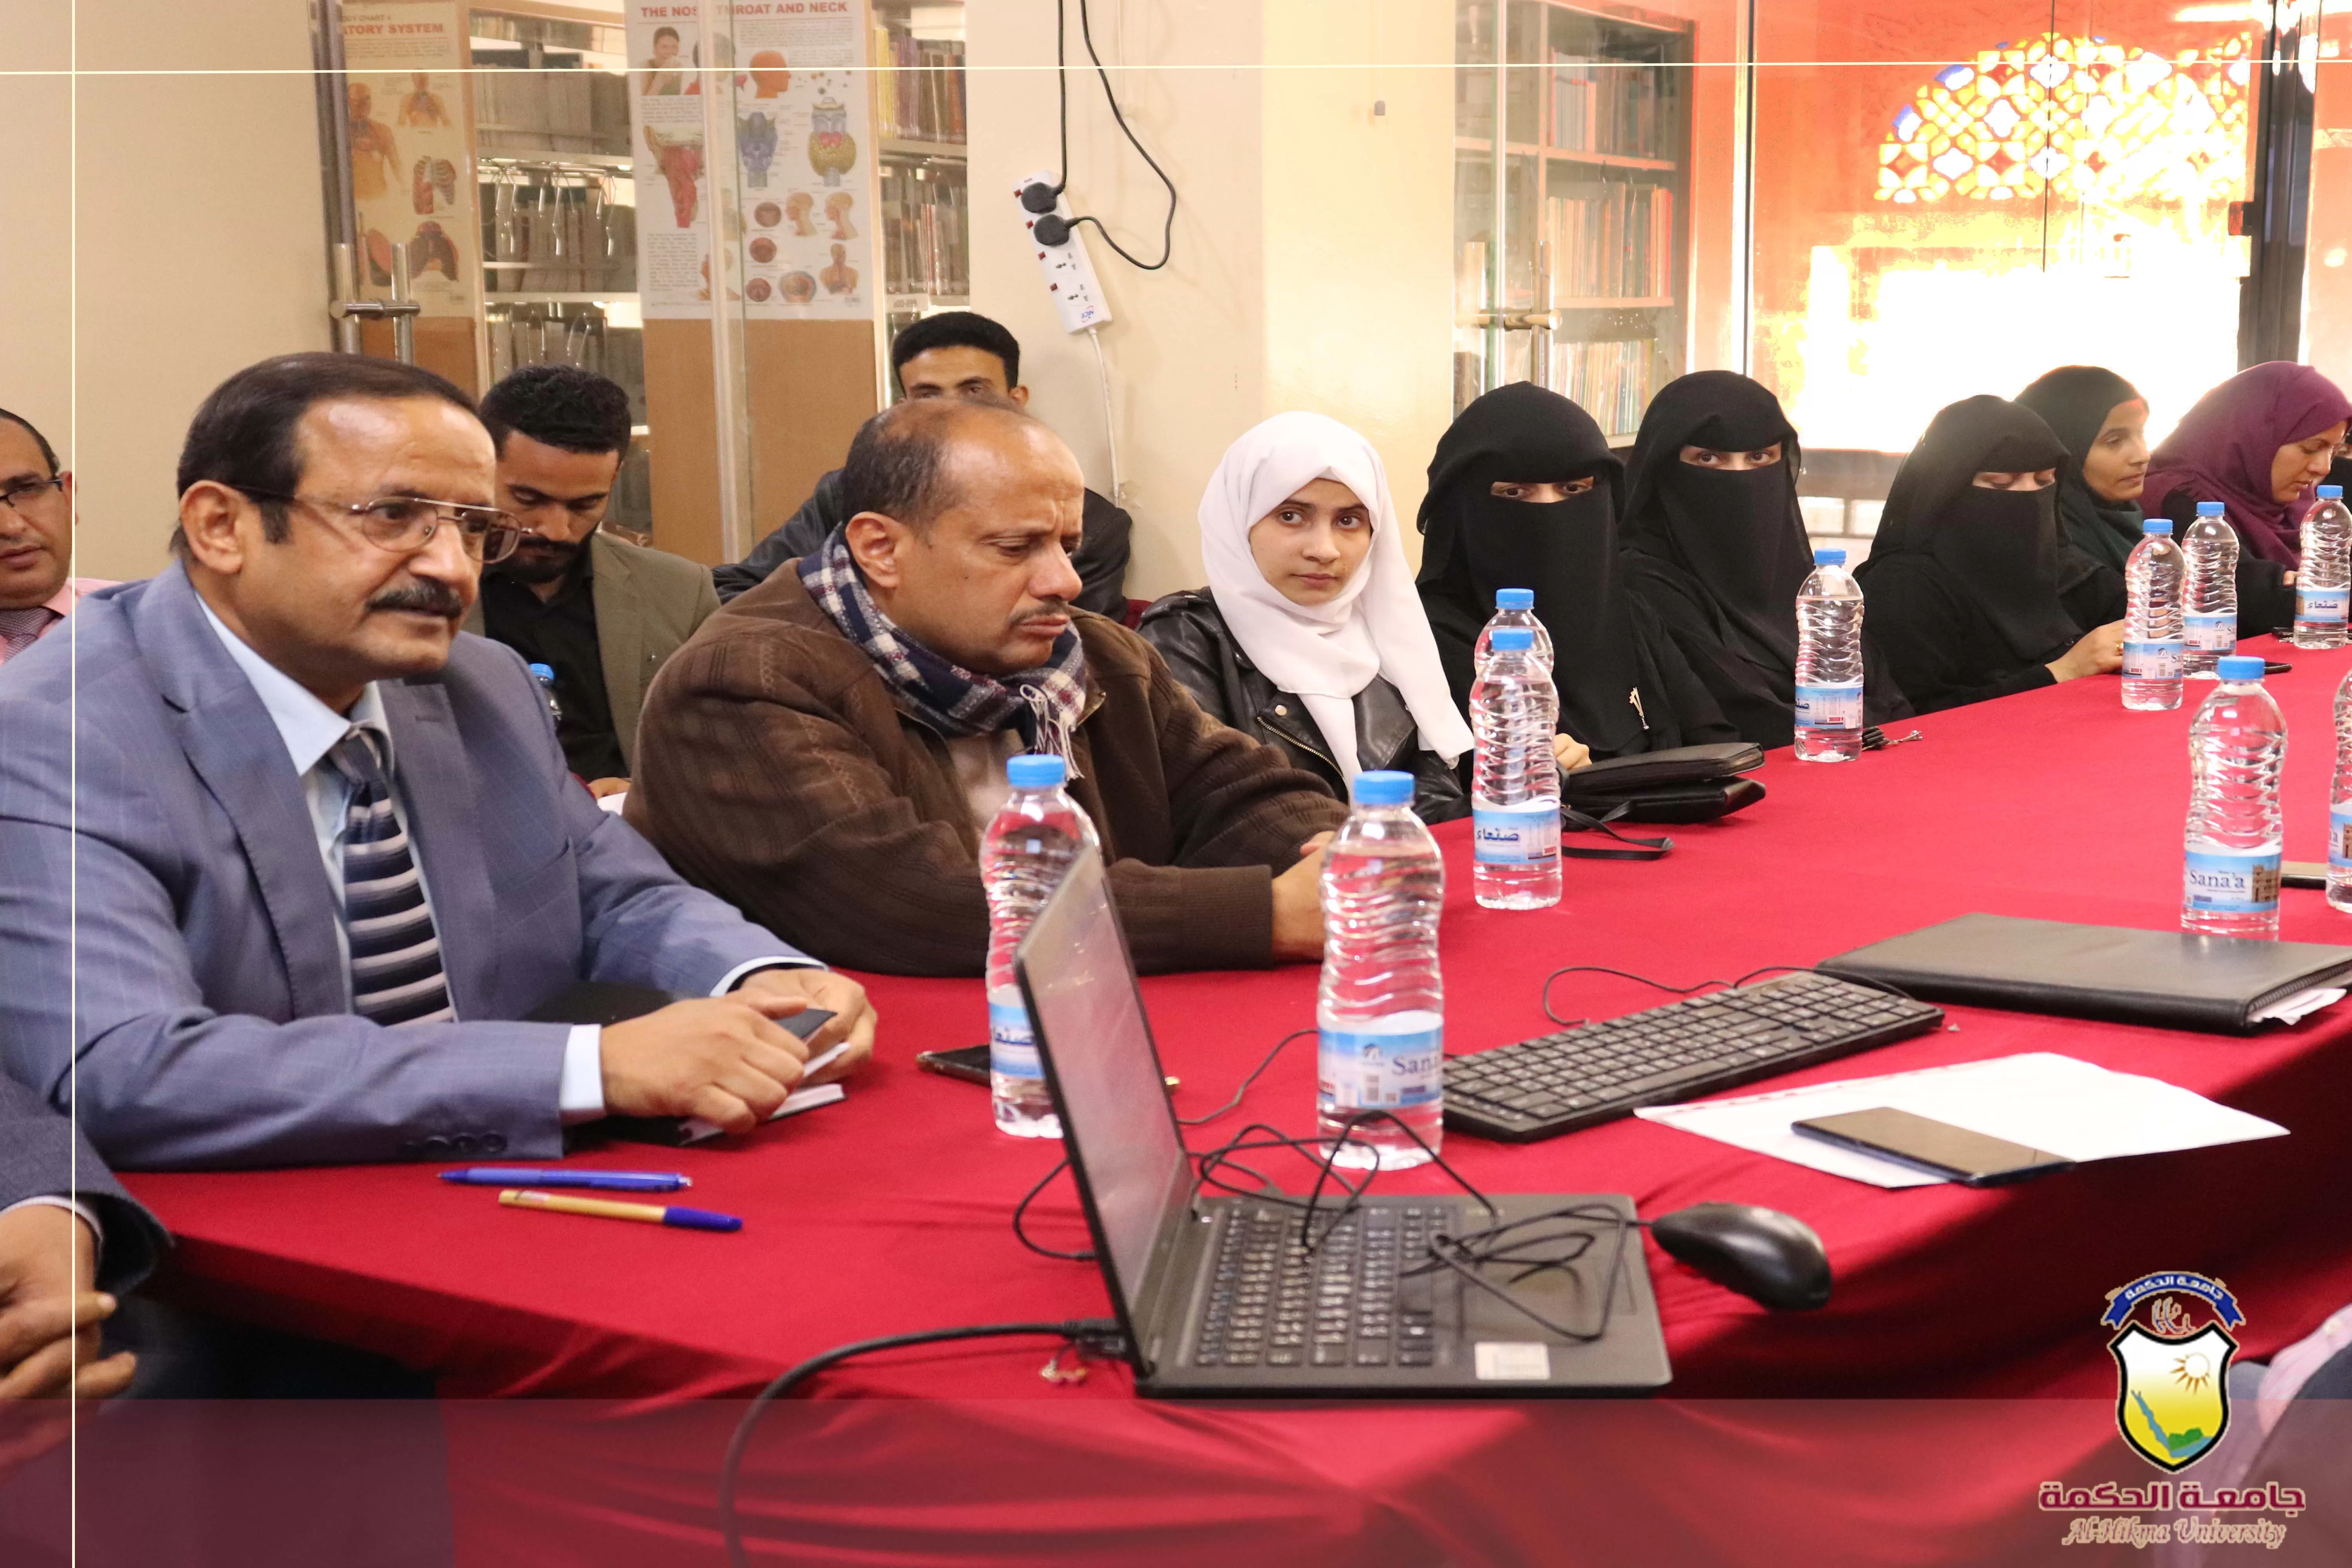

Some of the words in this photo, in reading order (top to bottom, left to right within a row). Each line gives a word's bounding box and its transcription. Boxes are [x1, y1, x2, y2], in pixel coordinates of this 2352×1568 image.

[641, 7, 667, 16] THE
[775, 3, 804, 13] AND
[809, 1, 847, 13] NECK
[388, 24, 444, 33] SYSTEM
[1477, 827, 1520, 841] صنعاء
[2189, 869, 2245, 888] Sana'a
